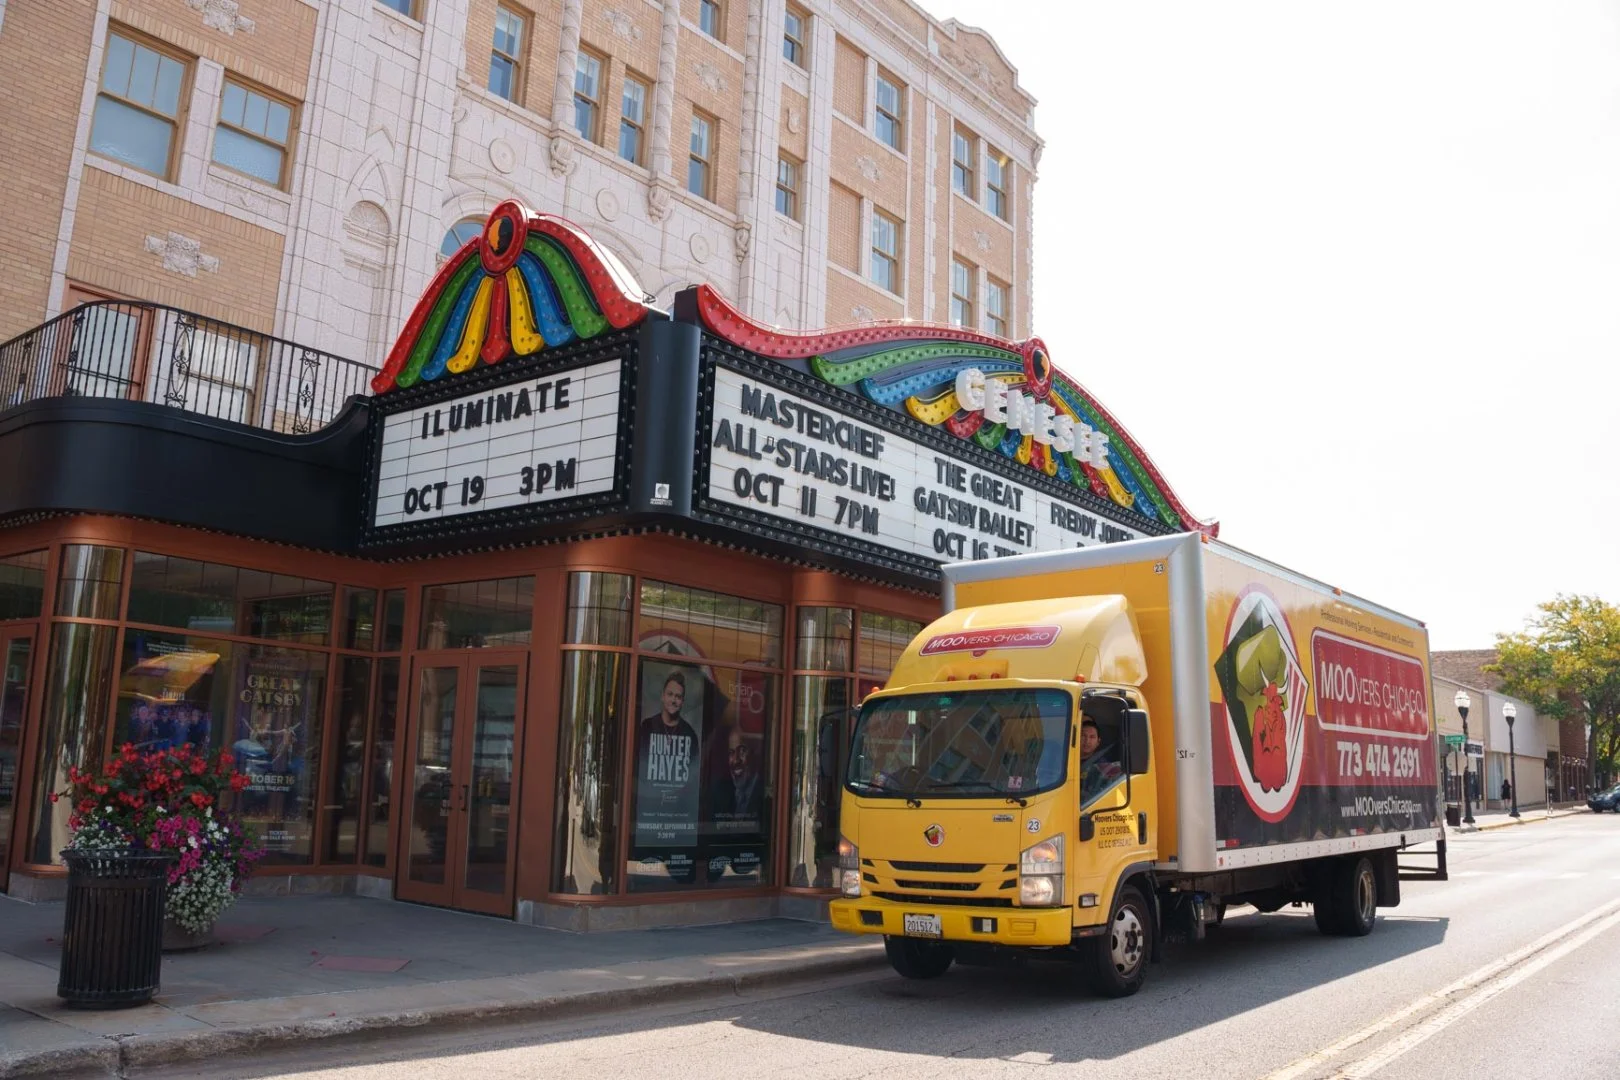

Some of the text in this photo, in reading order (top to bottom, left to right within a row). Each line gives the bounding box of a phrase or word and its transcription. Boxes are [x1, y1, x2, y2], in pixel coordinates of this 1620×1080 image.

[421, 377, 571, 439] ILUMINATE
[741, 384, 885, 459] MASTERCHEF
[955, 367, 1109, 470] GENESEE
[404, 457, 576, 515] OCT 19 3PM
[713, 418, 896, 502] ALL-STARS LIVE!
[934, 456, 1024, 513] THE GREAT
[734, 467, 879, 536] OCT 11 7PM
[913, 486, 1035, 548] GATSBY BALLET
[1051, 501, 1097, 540] FREDDY
[933, 528, 967, 561] OCT
[927, 632, 1050, 649] MOOVERS CHICAGO
[1320, 660, 1423, 715] MOOVERS CHICAGO
[647, 753, 690, 782] HAYES
[649, 732, 692, 757] HUNTER
[1337, 741, 1420, 778] 773 474 2691
[248, 773, 283, 785] TOBER
[1028, 820, 1040, 831] 23
